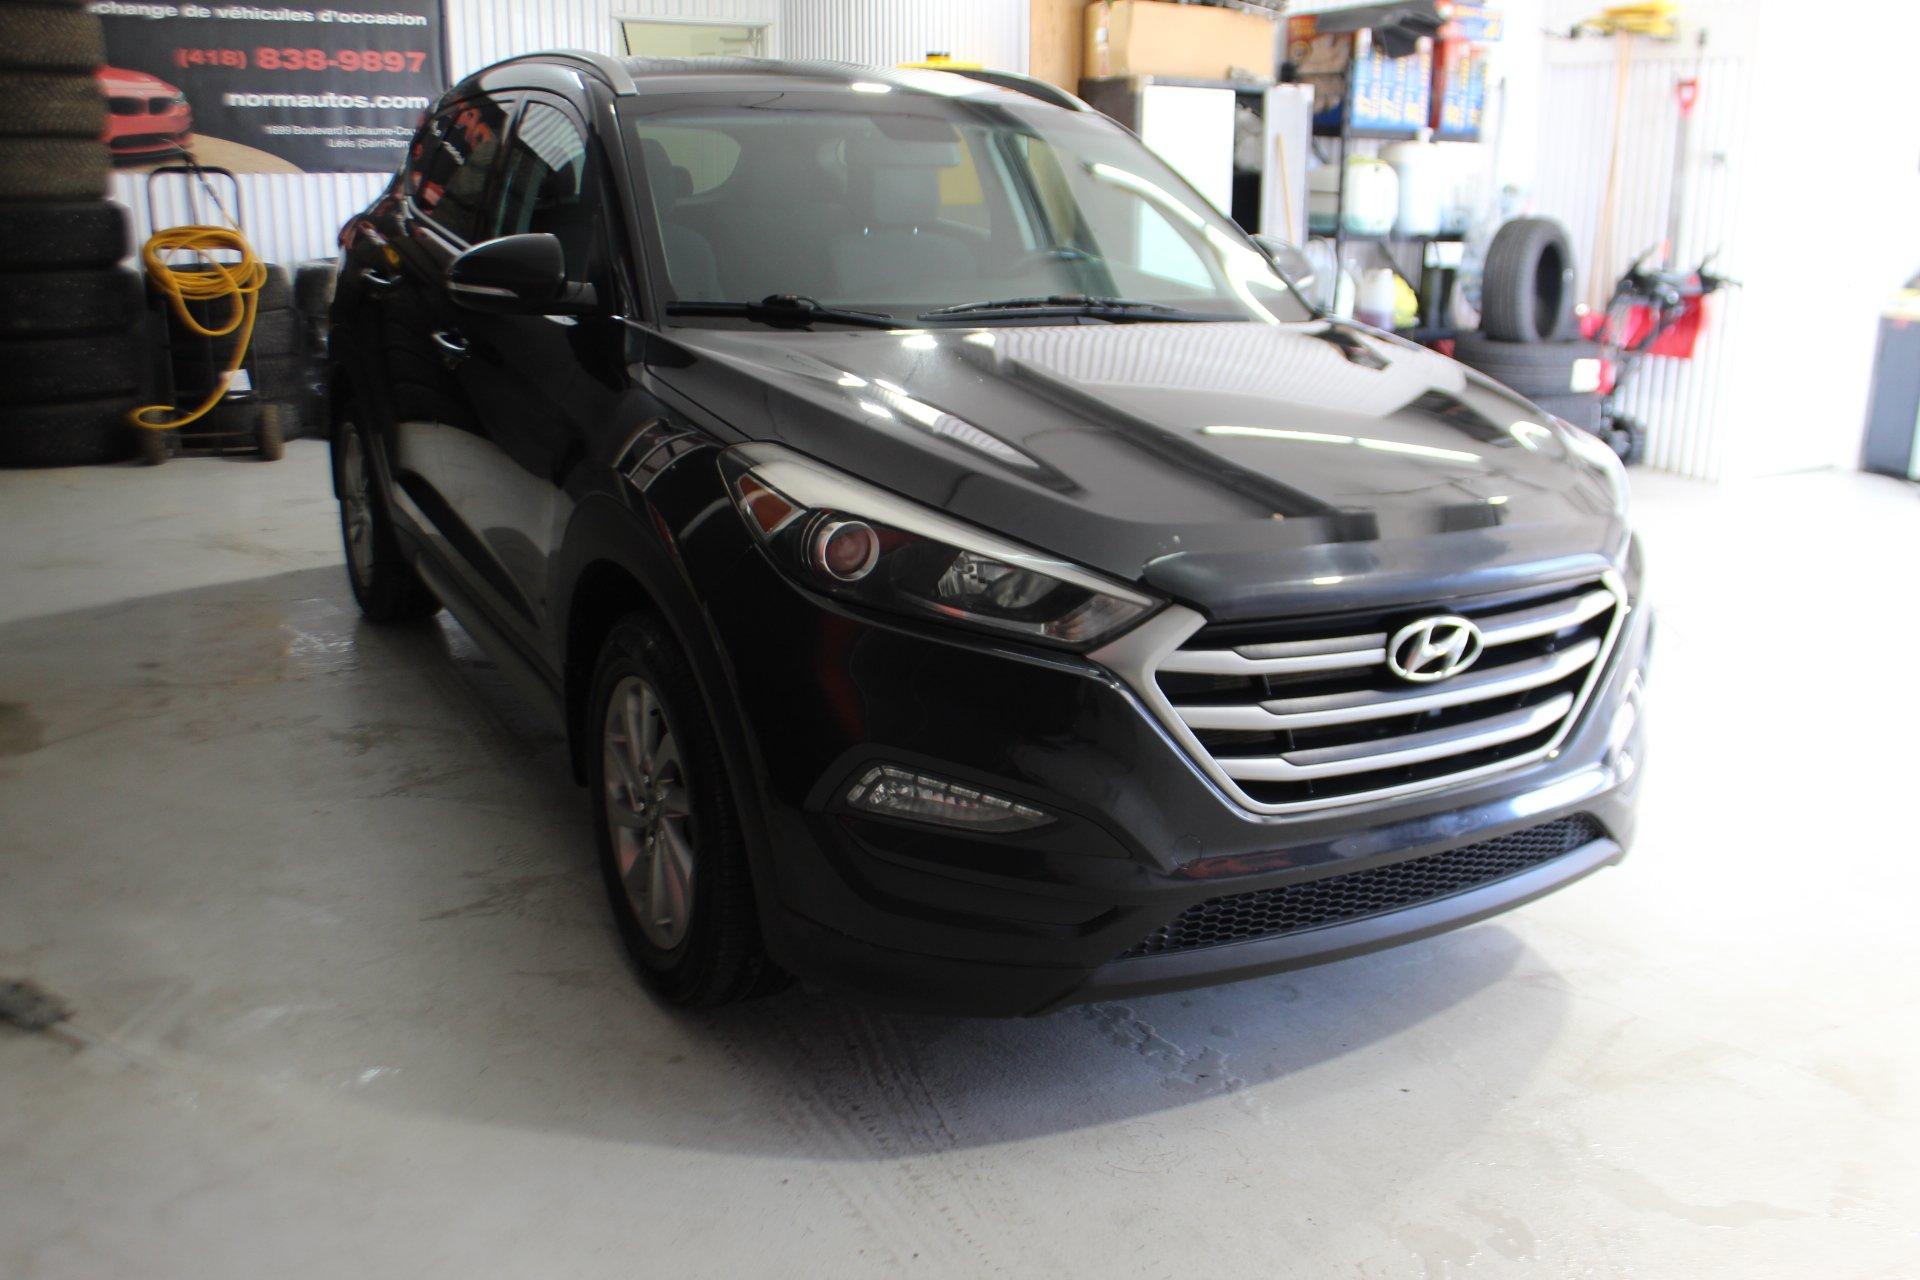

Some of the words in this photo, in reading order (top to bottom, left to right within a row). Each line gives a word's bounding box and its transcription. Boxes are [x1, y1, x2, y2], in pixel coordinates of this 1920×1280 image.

[183, 5, 211, 18] de
[215, 6, 315, 21] véhicules
[318, 9, 427, 25] d'occasion
[176, 48, 247, 69] (418)
[256, 47, 426, 72] 838-9897
[224, 92, 429, 109] normautos.com
[293, 125, 343, 136] Boulevard
